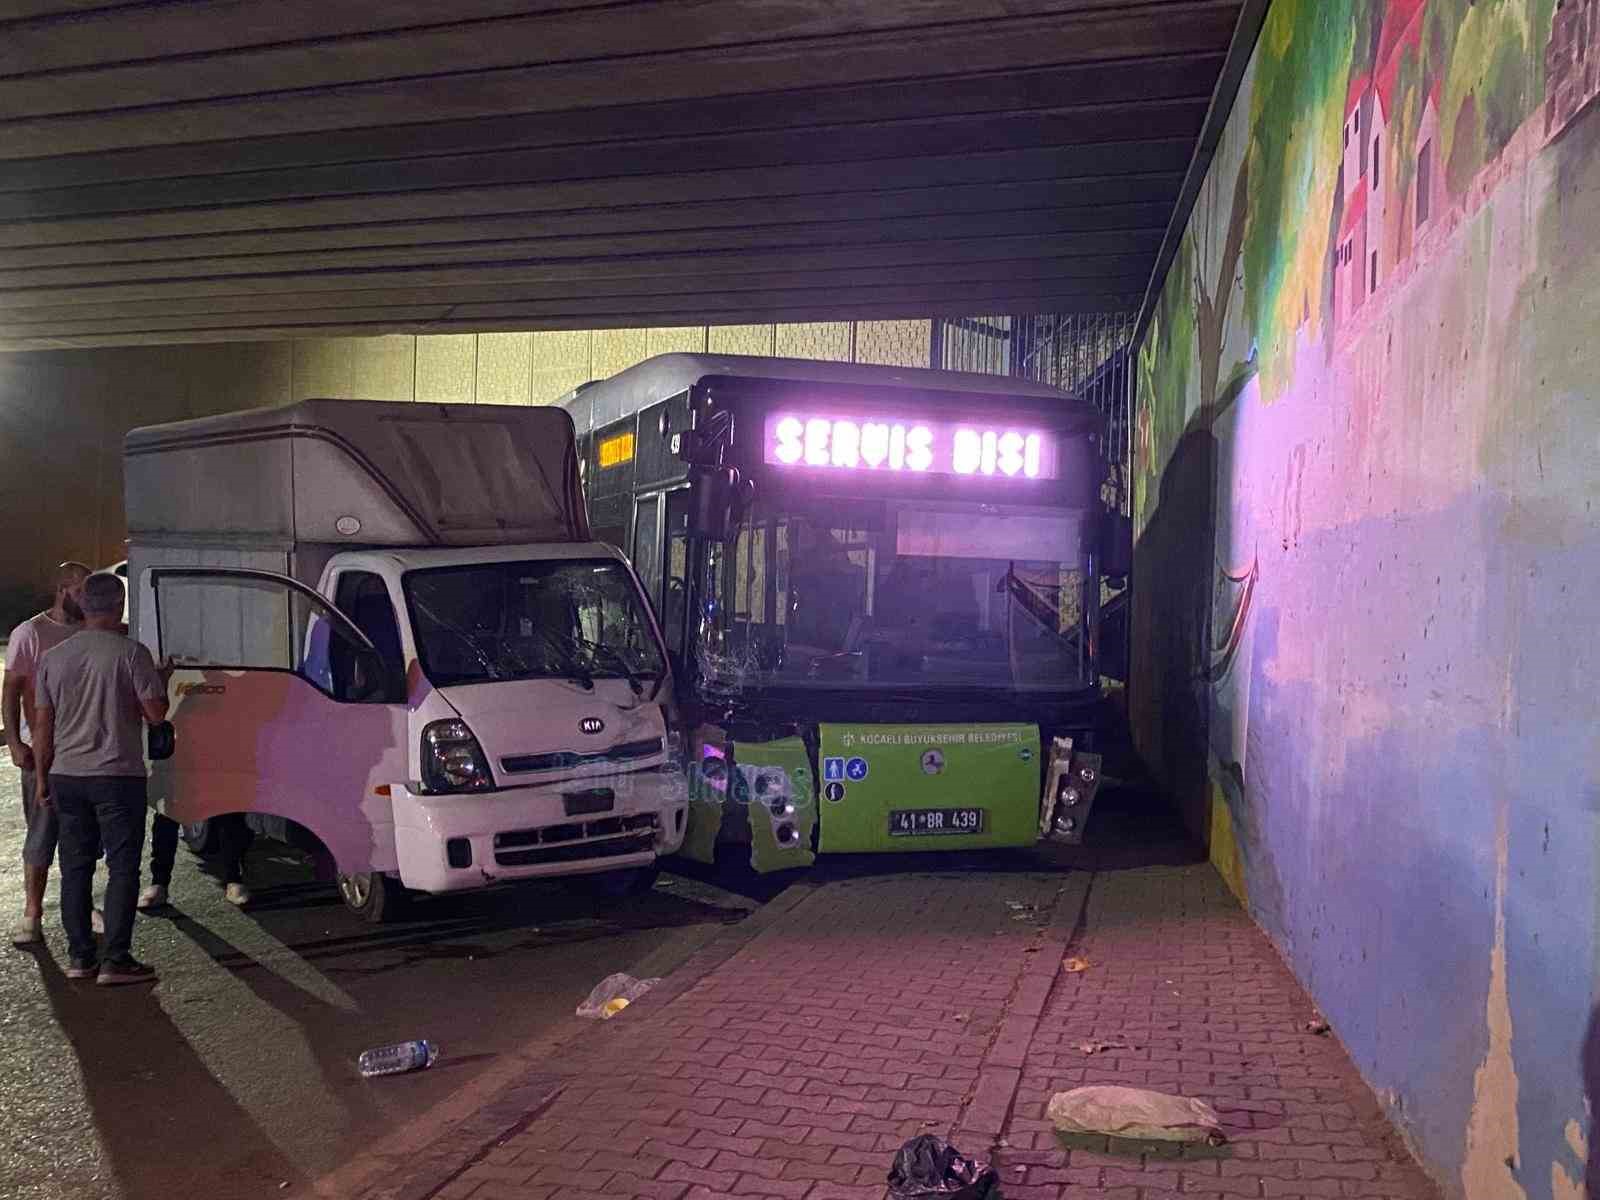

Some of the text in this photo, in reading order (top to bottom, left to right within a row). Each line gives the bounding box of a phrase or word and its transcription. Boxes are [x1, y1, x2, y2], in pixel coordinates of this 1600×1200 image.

[900, 810, 977, 829] 41 BR 439
